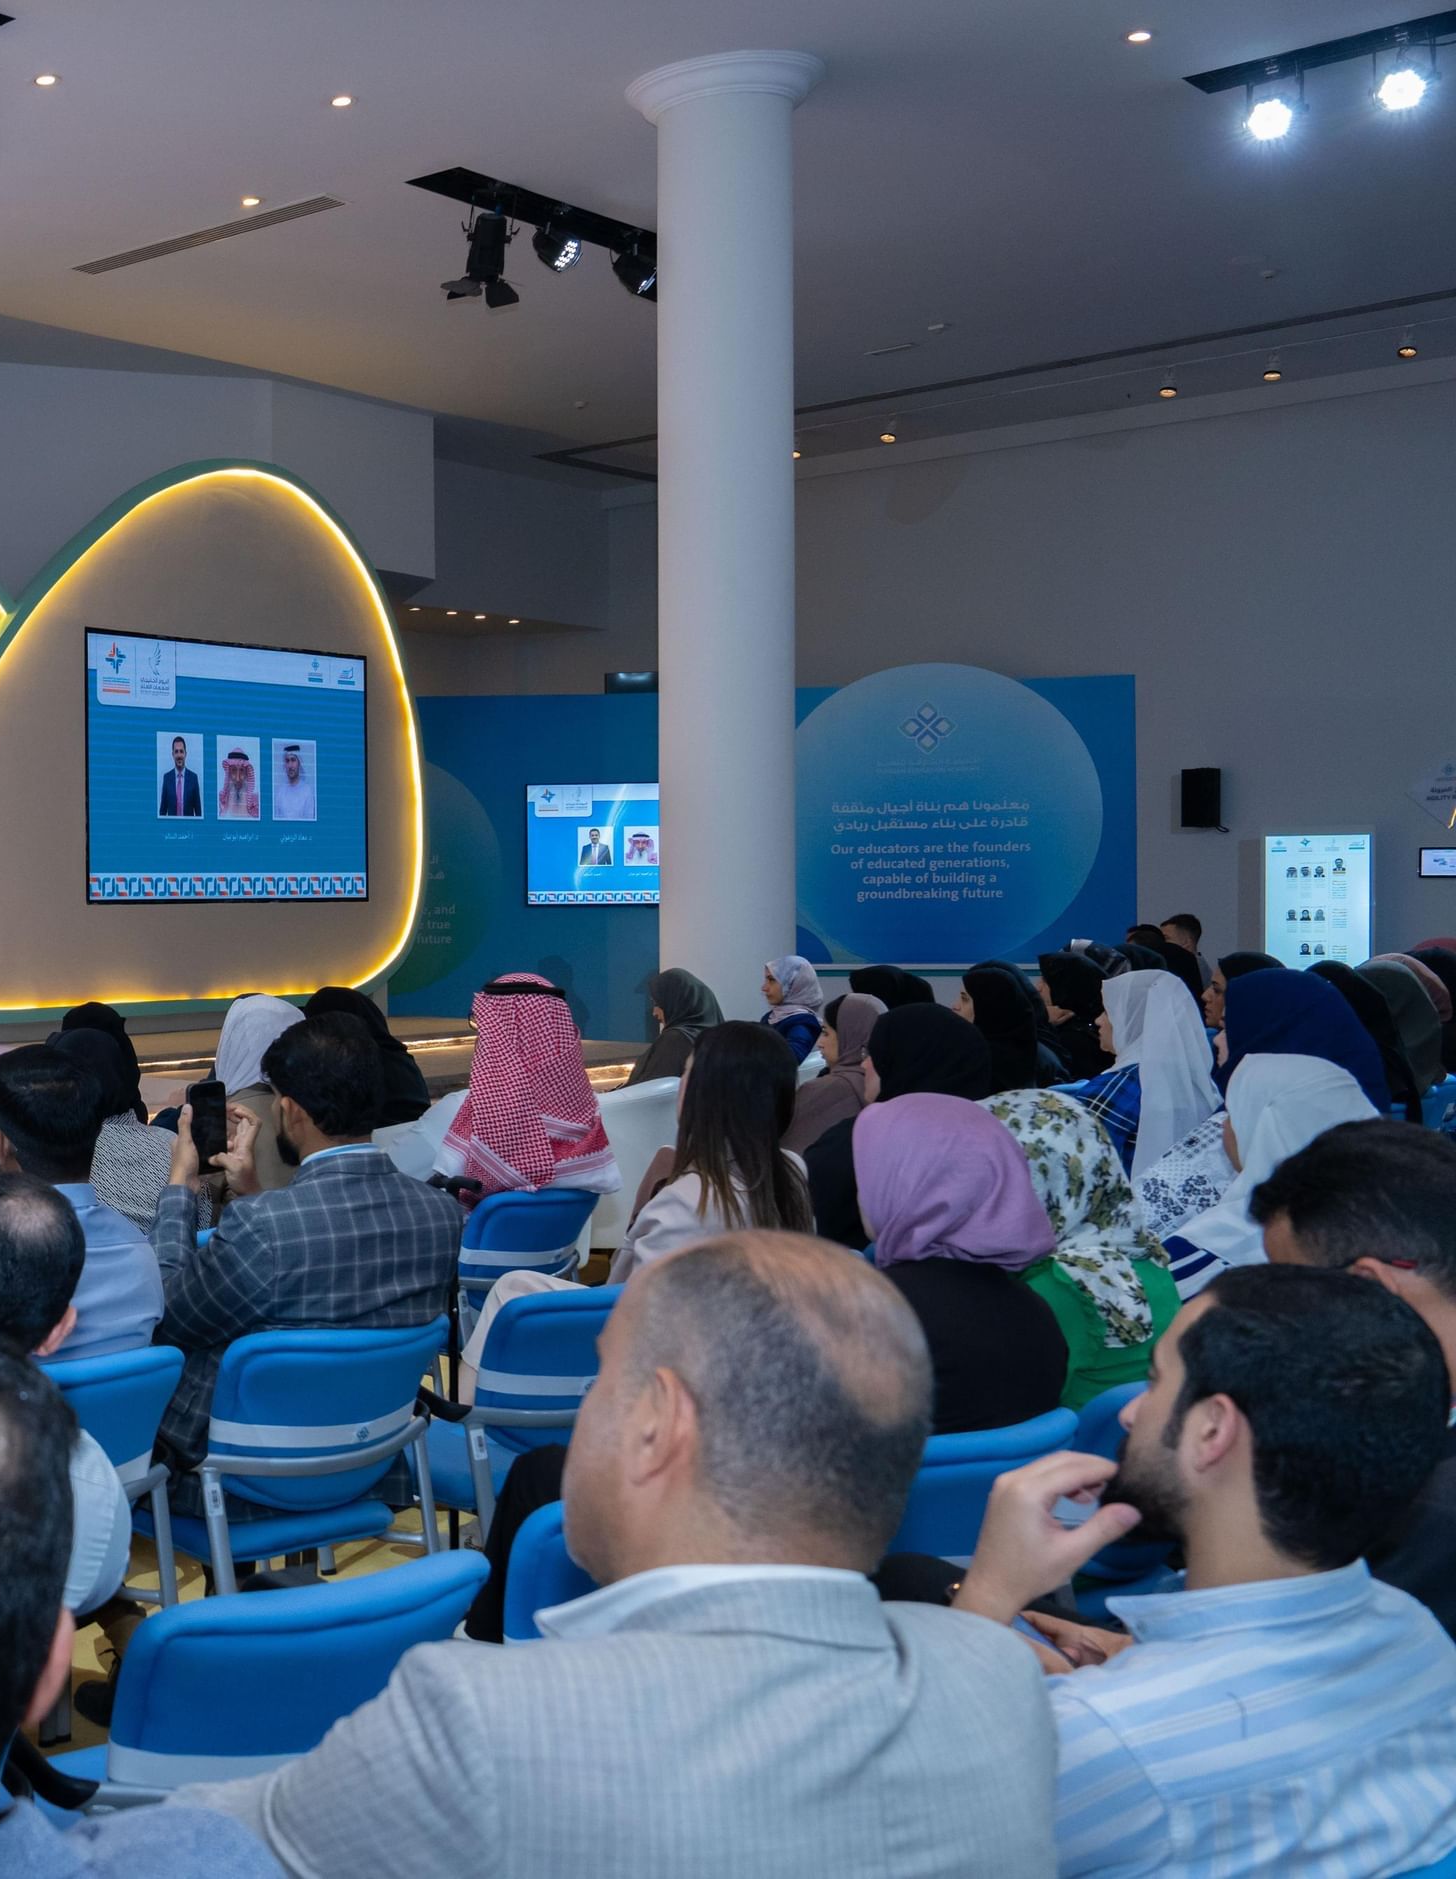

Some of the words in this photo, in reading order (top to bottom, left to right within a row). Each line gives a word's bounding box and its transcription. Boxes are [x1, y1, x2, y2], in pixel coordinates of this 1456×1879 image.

[877, 800, 913, 815] أجيال
[943, 801, 969, 813] هم
[871, 818, 929, 832] مستقبل
[932, 817, 957, 831] بناء
[959, 818, 988, 831] على
[990, 817, 1029, 830] قادرة
[831, 844, 855, 855] Our
[857, 843, 920, 855] educators
[923, 844, 944, 854] are
[948, 842, 969, 854] the
[972, 841, 1032, 854] founders
[850, 858, 864, 869] of
[867, 858, 926, 869] educated
[929, 857, 1011, 871] generations,
[862, 873, 912, 887] capable
[915, 872, 930, 884] of
[932, 872, 986, 886] building
[989, 874, 998, 883] a
[856, 887, 960, 903] groundbreaking
[962, 887, 1004, 899] future
